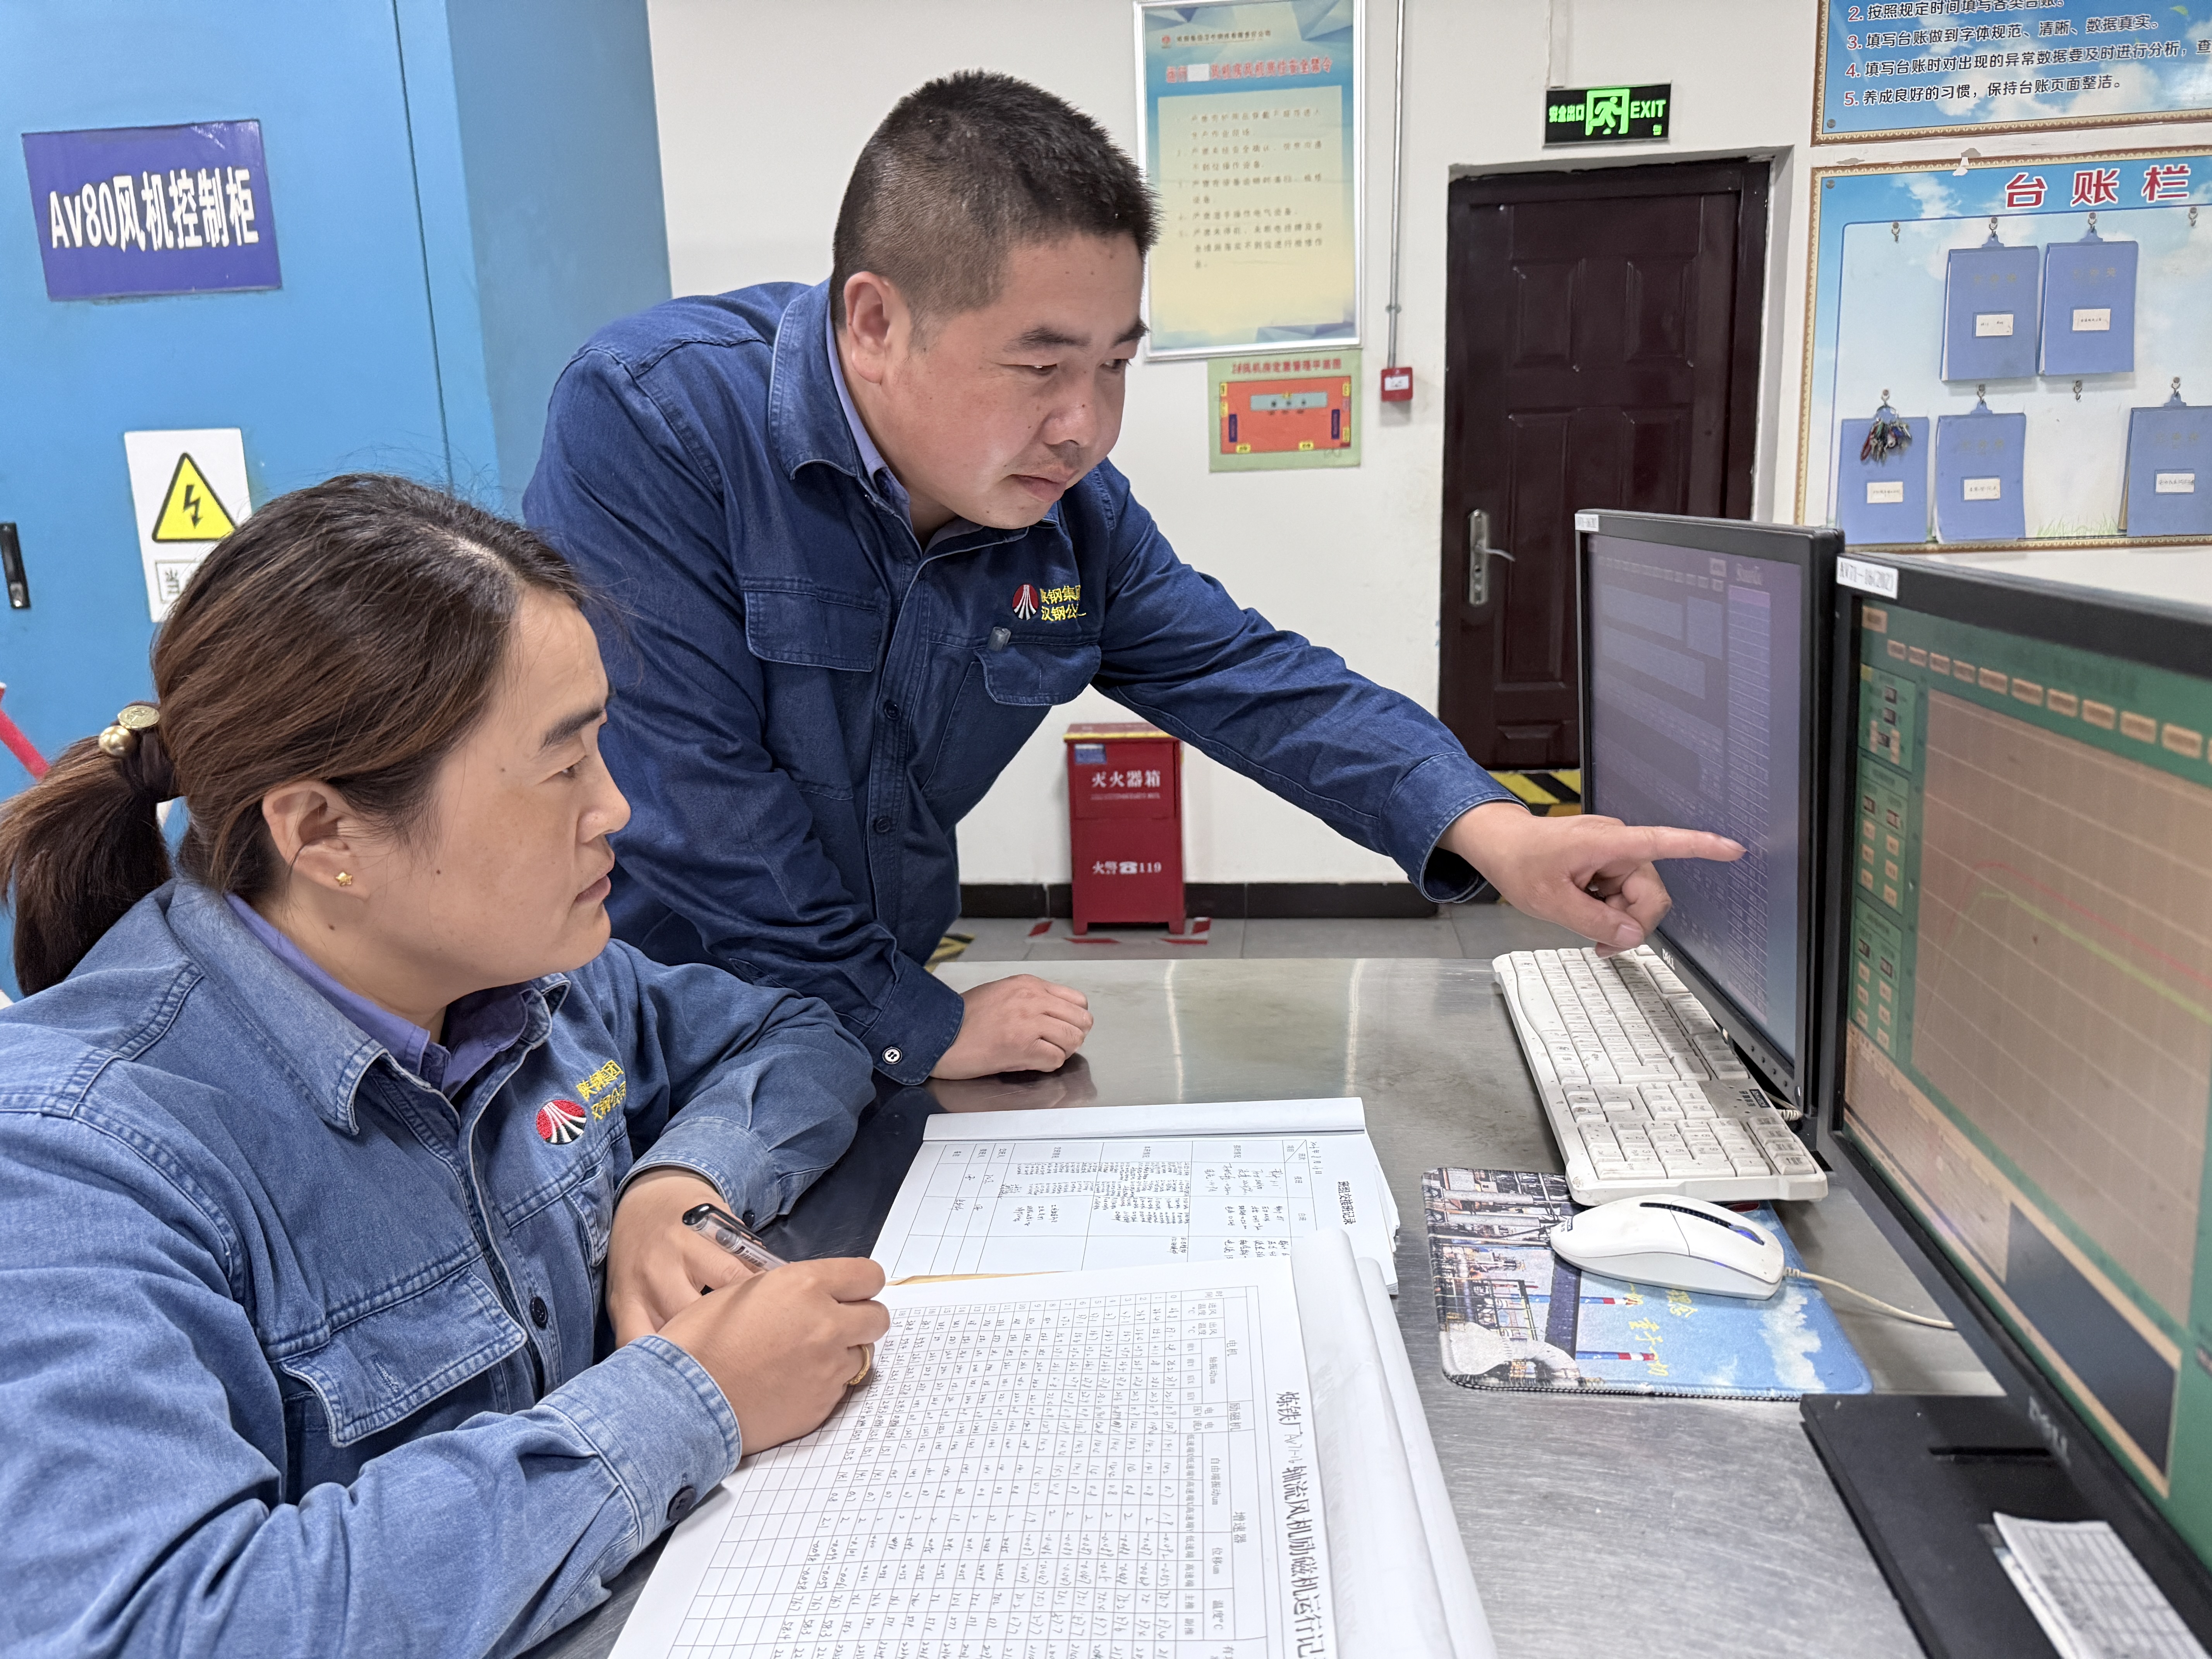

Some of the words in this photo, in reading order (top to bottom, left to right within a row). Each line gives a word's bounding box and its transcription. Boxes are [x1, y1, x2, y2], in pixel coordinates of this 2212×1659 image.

[1630, 100, 1666, 118] EXIT
[1041, 603, 1087, 621] 汉钢公
[1092, 770, 1160, 788] 灭火器箱
[1662, 948, 1675, 971] DELL
[1338, 1182, 1356, 1224] 班组交接班记录
[1226, 1340, 1238, 1356] 电机
[1229, 1403, 1241, 1431] 励磁机
[1233, 1512, 1246, 1543] 增速器
[1185, 1535, 1194, 1558] 低速端
[1282, 1466, 1325, 1659] 轴流风机励磁机运行记
[1185, 1563, 1194, 1587] 高速端
[1185, 1593, 1194, 1610] 主推
